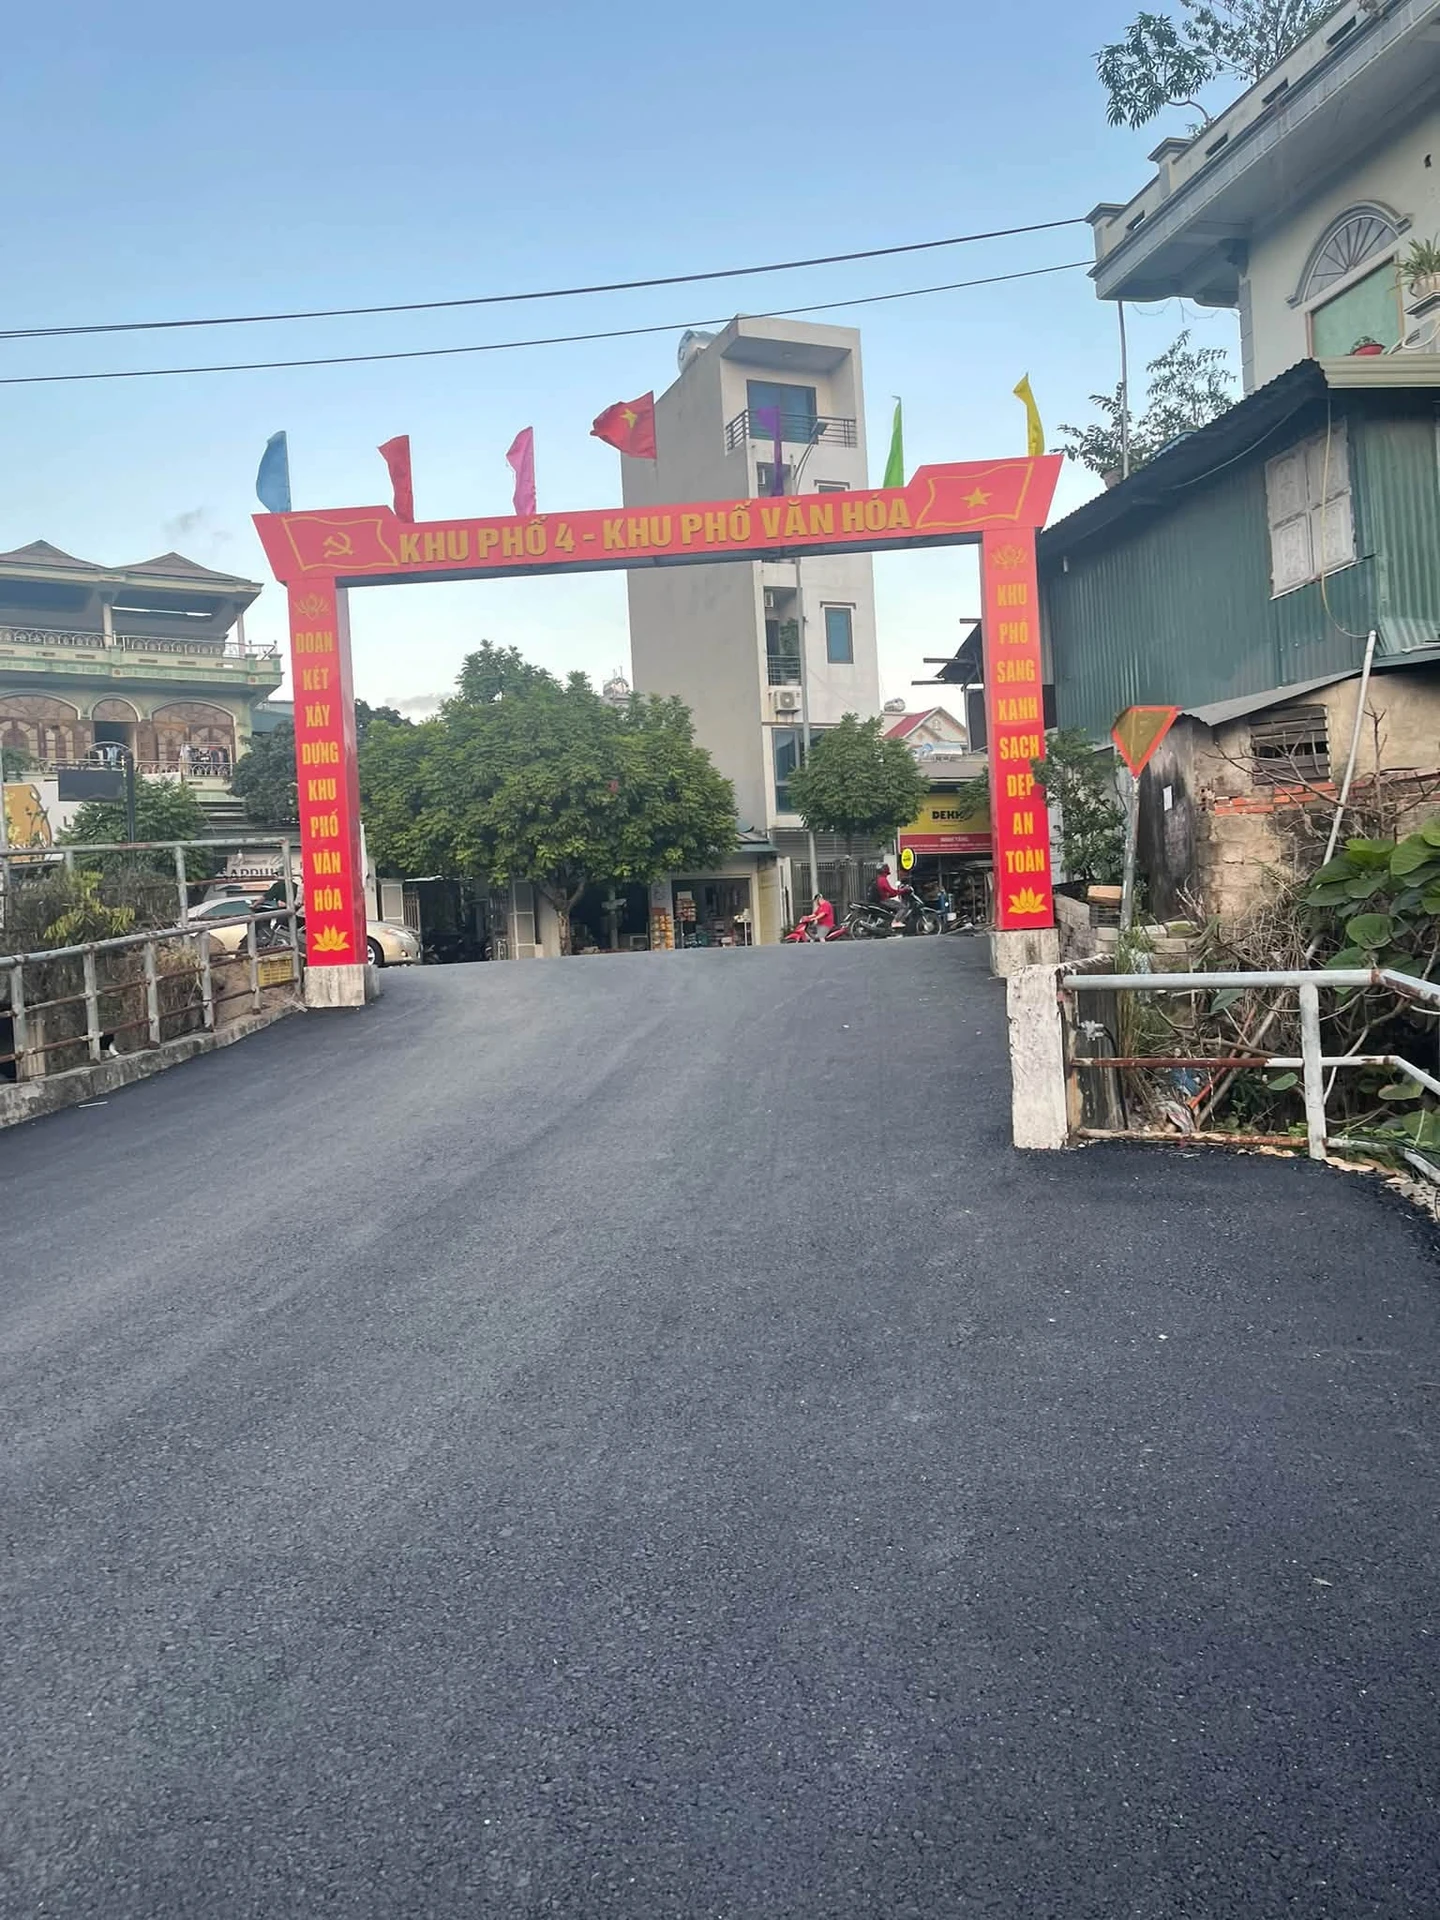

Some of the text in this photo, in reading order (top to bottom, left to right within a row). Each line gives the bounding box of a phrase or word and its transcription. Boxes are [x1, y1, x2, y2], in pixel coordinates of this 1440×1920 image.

[400, 530, 470, 564] KHU
[478, 515, 548, 559] PHỐ
[555, 522, 576, 552] 4
[602, 516, 672, 549] KHU
[680, 500, 752, 544] PHỐ
[760, 501, 834, 538] VĂN
[841, 494, 911, 532] HÓA
[997, 583, 1028, 606] KHU
[305, 701, 331, 728] XÂY
[998, 697, 1039, 721] XANH
[1000, 735, 1040, 762] SẠCH
[308, 778, 337, 801] KHU
[1013, 812, 1034, 835] AN
[312, 849, 341, 874] VĂN
[1005, 846, 1045, 873] TOÀN
[314, 885, 343, 912] HÓA
